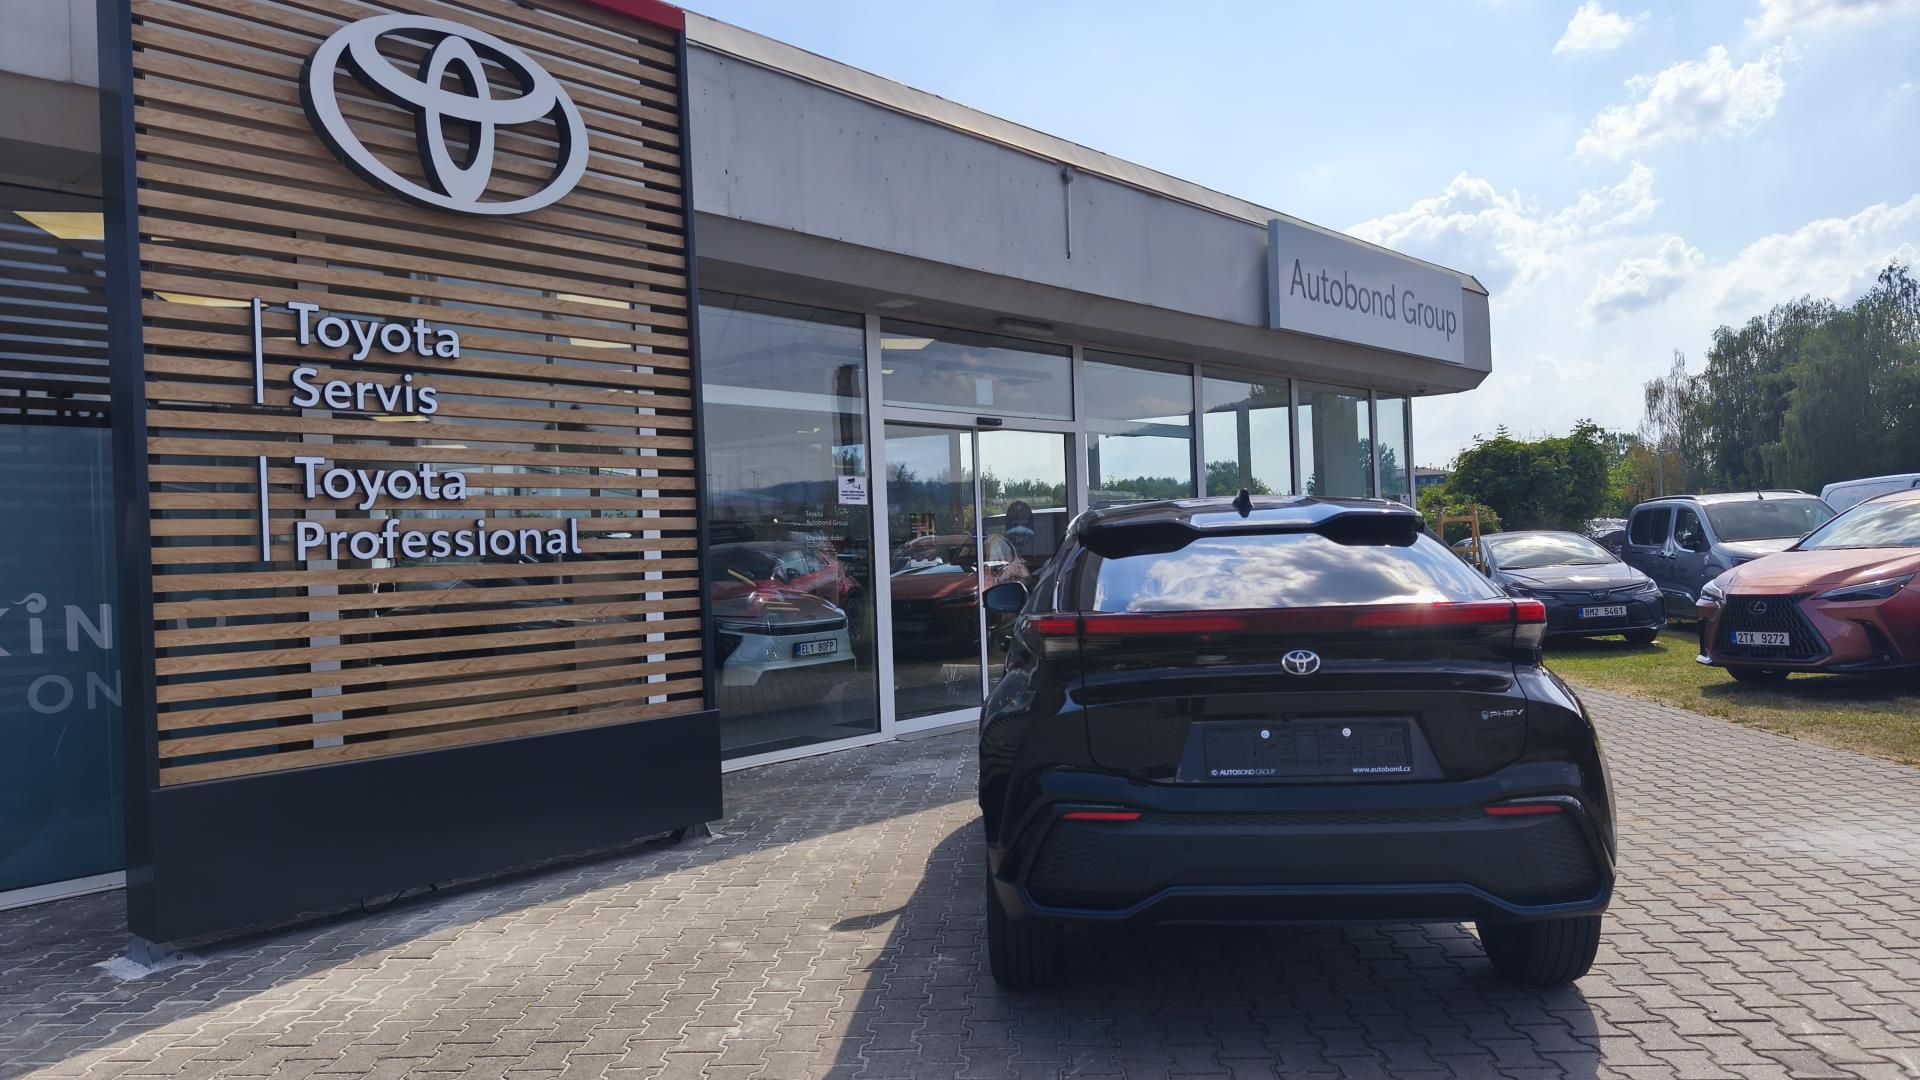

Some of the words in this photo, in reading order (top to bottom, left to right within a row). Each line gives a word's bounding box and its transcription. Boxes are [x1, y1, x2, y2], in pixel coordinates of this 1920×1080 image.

[1290, 258, 1396, 320] Autobond
[1402, 290, 1456, 342] Group
[287, 301, 461, 361] Toyota
[291, 367, 439, 414] Servis
[294, 456, 468, 511] Toyota
[805, 510, 824, 518] Toyota
[297, 517, 582, 561] Professional
[1584, 607, 1600, 617] 8M2
[1604, 606, 1624, 616] 5461
[1737, 632, 1755, 644] 2TX
[1761, 633, 1785, 645] 9272
[1489, 708, 1524, 719] PHEV
[1219, 768, 1255, 776] AUTOBOND
[1255, 768, 1276, 776] GROUP
[1352, 765, 1412, 774] www.autobond.cz
